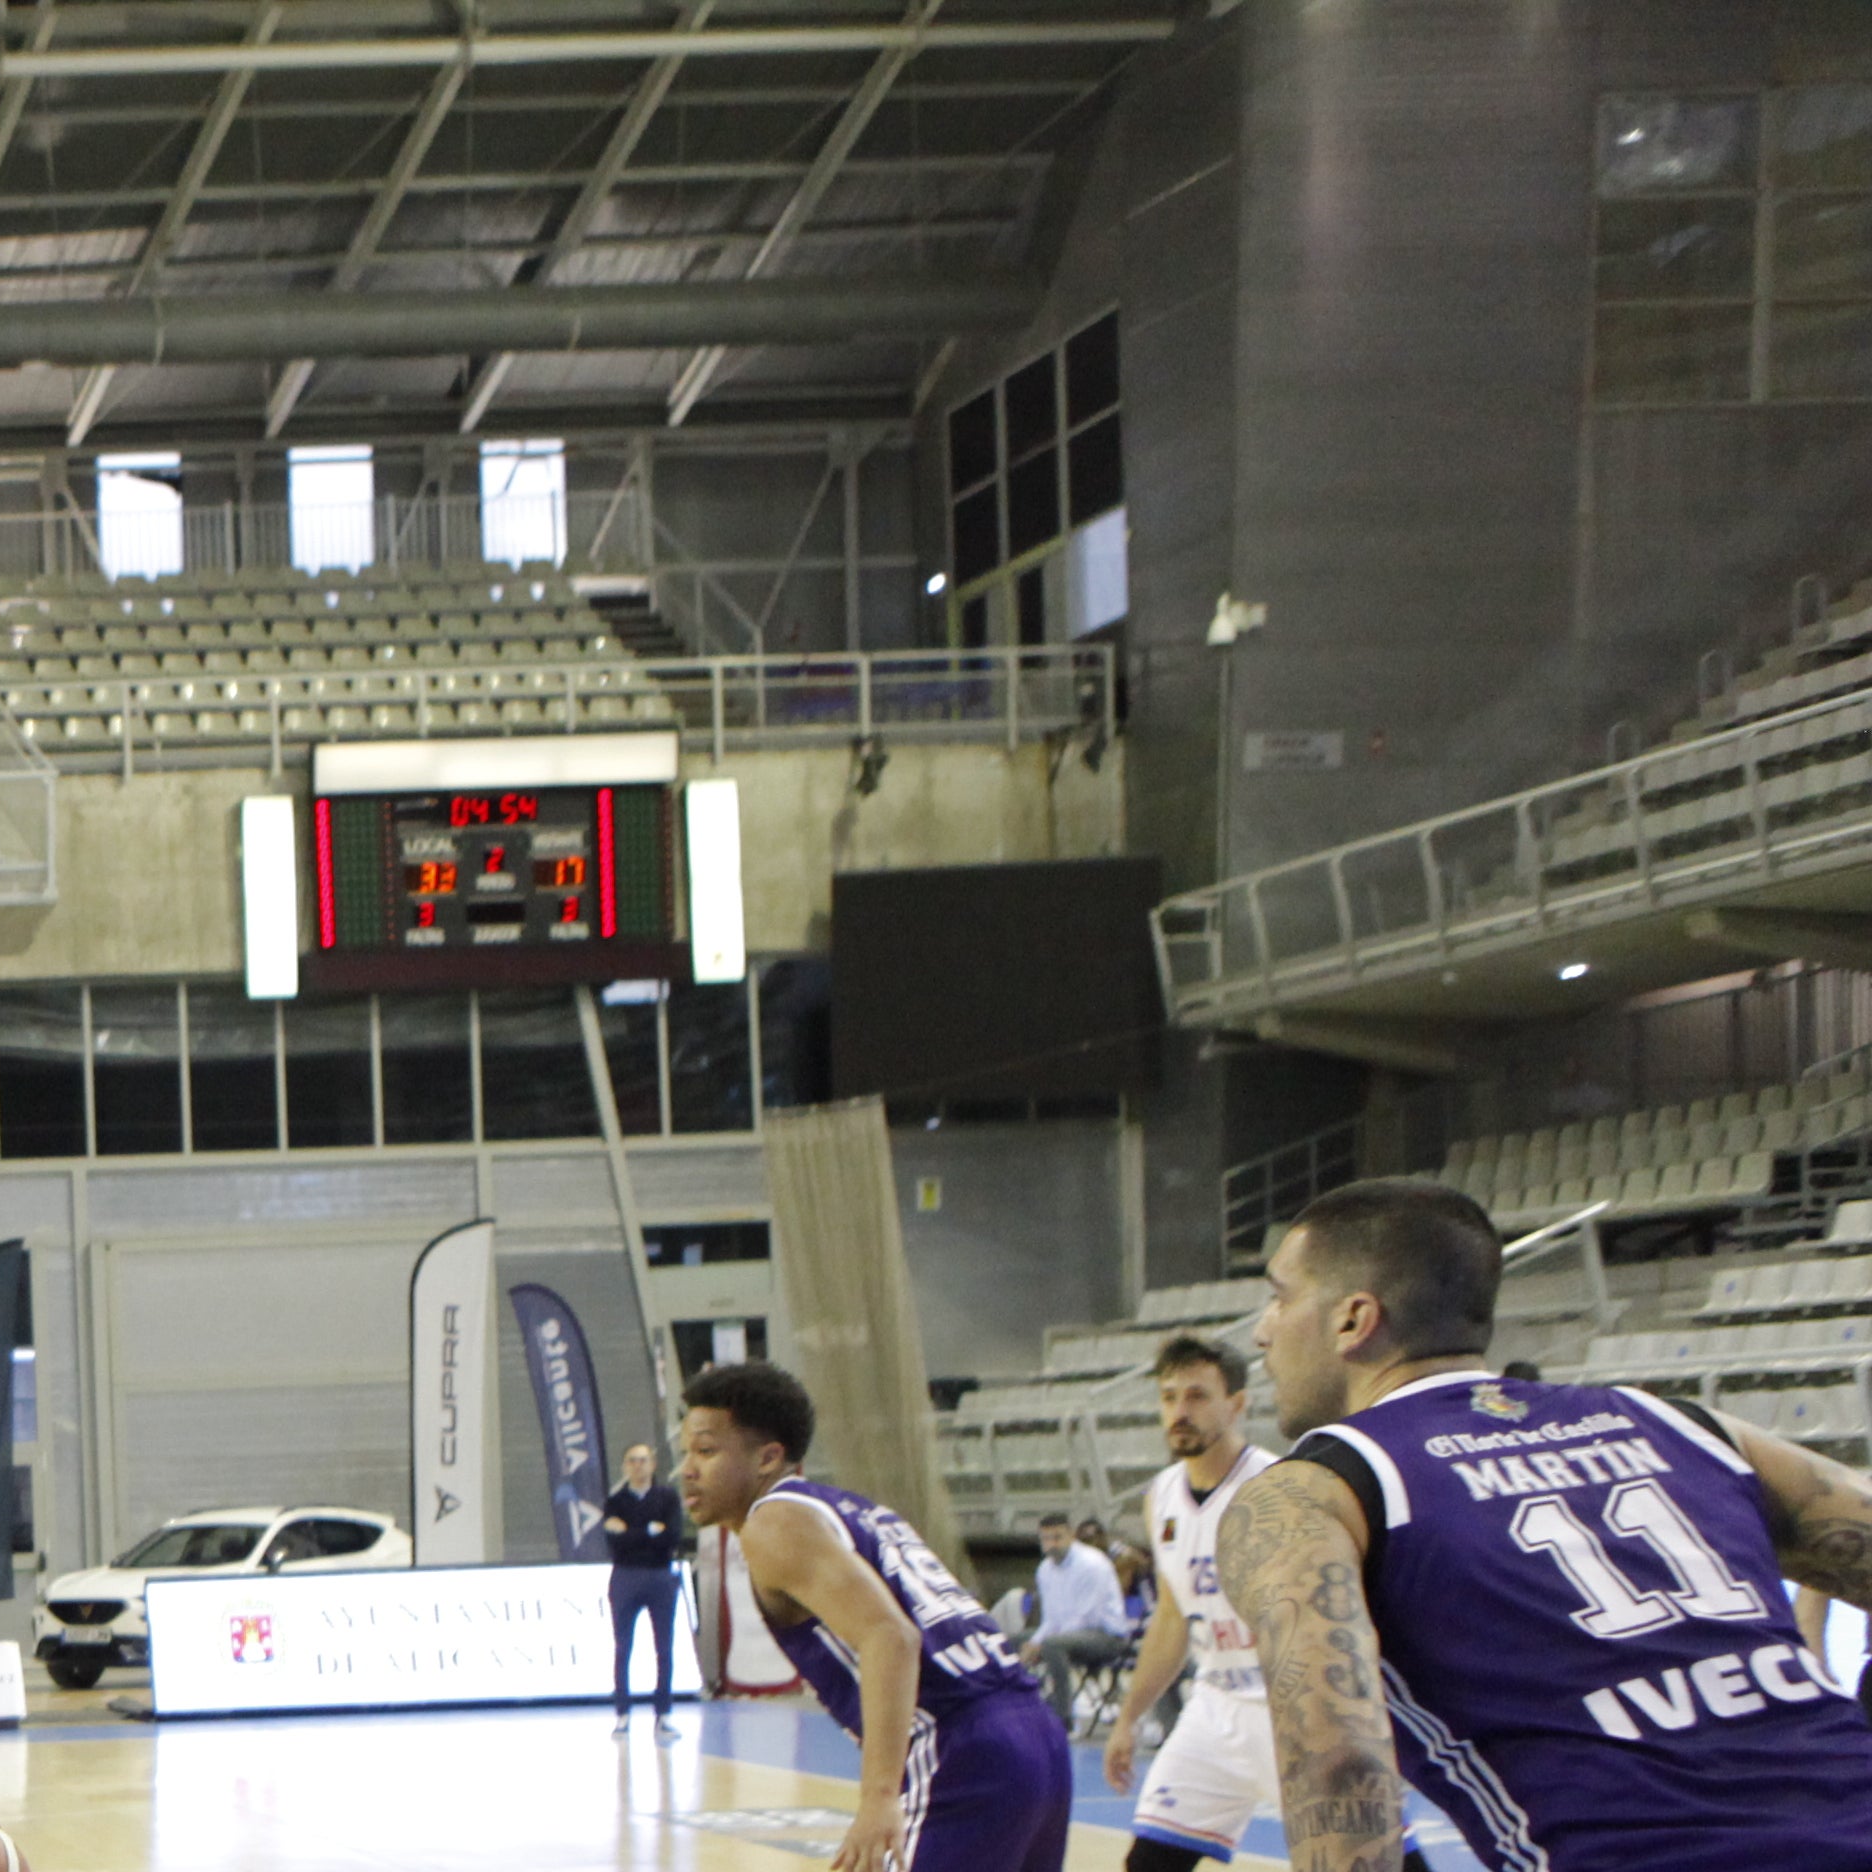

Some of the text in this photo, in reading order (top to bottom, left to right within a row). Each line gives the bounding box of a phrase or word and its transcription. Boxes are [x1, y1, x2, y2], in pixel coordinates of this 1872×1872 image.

[554, 854, 586, 886] 17
[440, 1304, 461, 1467] CUPRA
[1450, 1437, 1673, 1501] MARTÍN
[1508, 1477, 1770, 1640] 11
